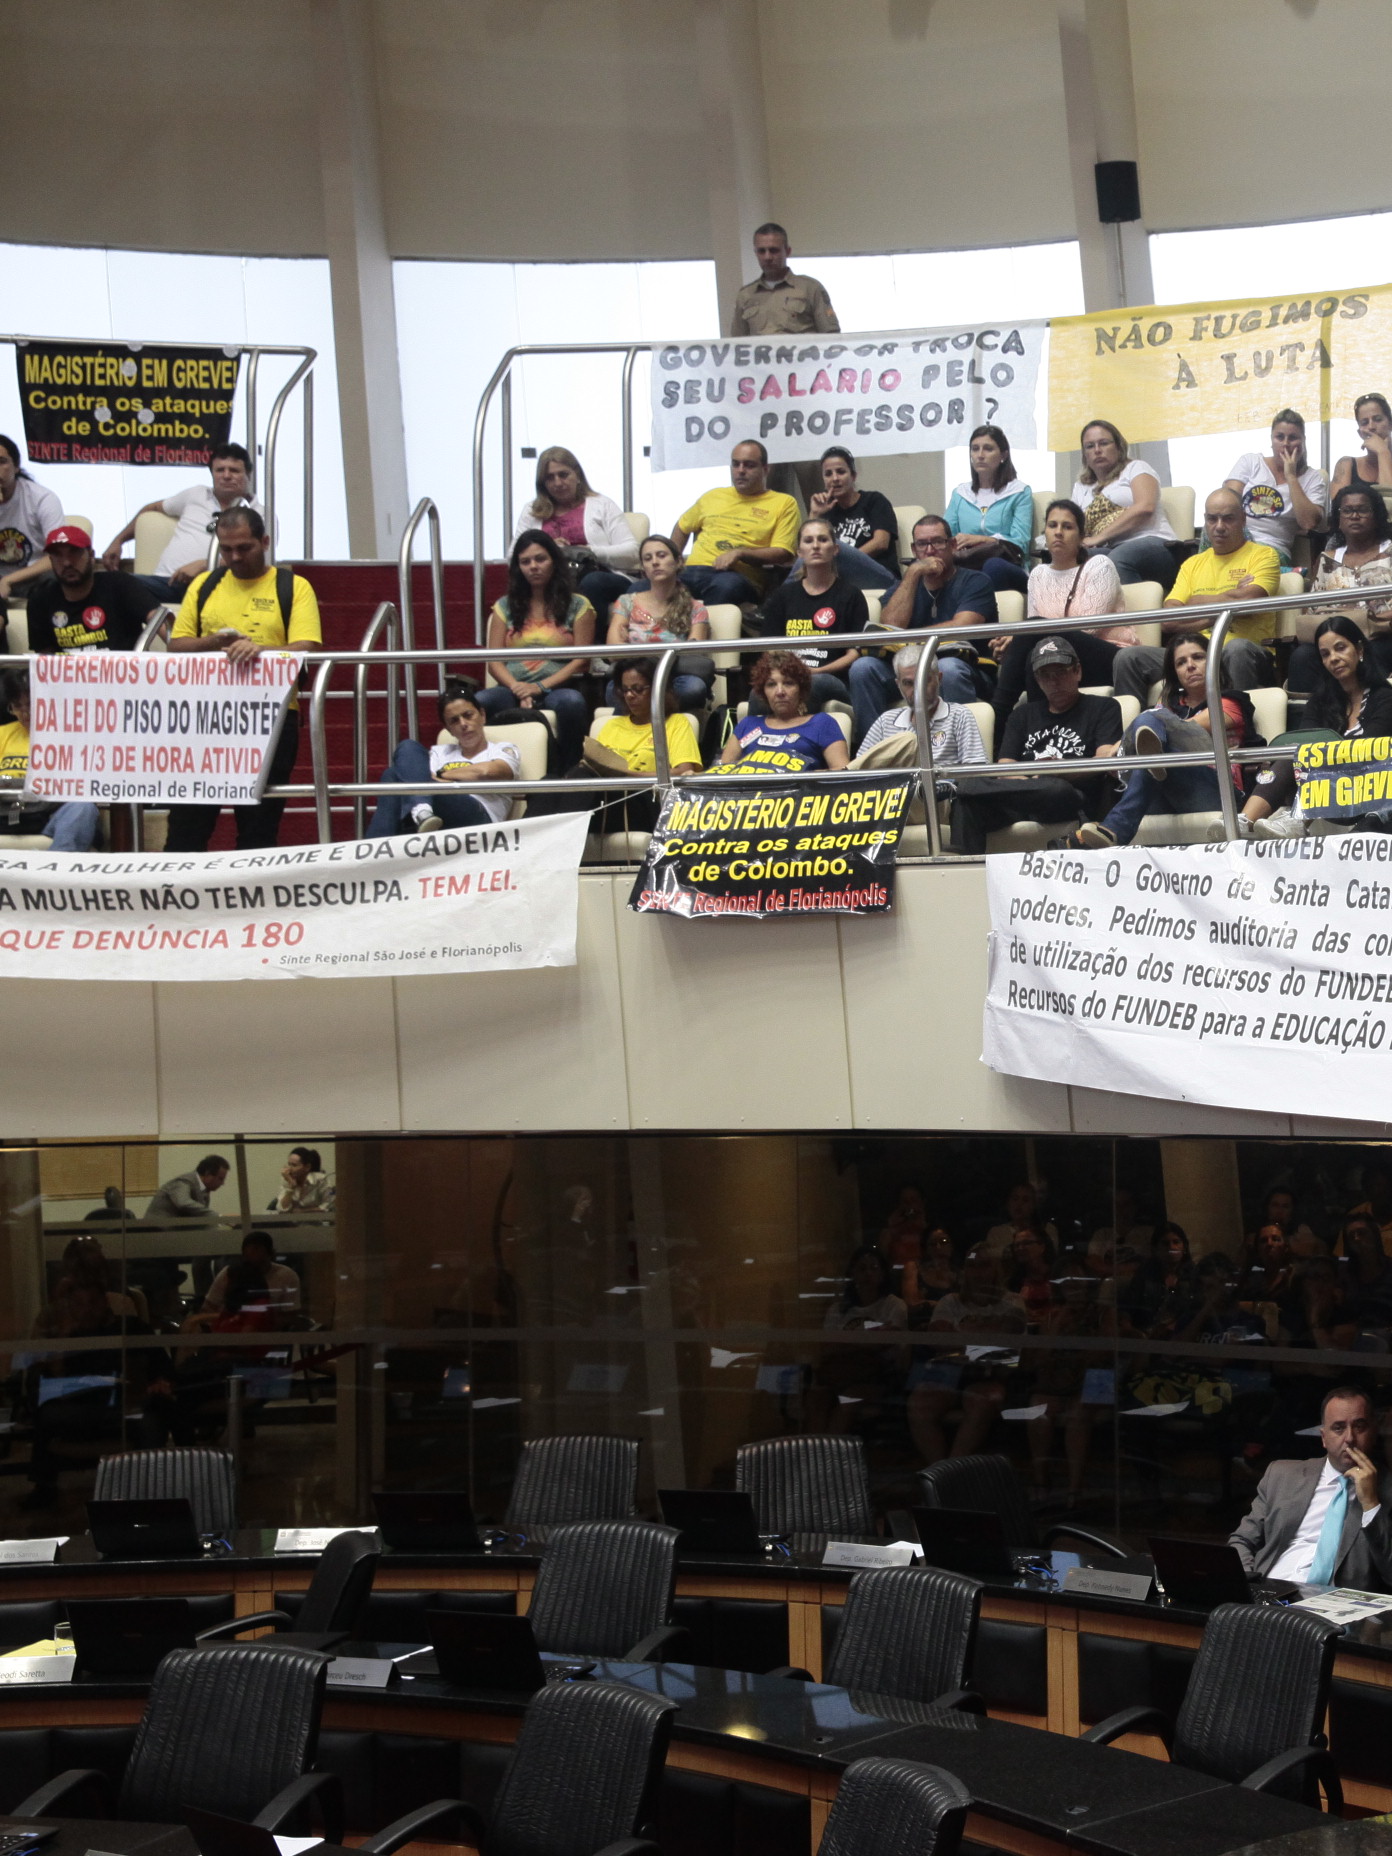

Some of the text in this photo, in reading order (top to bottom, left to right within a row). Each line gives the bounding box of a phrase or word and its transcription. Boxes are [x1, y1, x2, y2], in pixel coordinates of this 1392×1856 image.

[1095, 293, 1370, 356] NÃO FUGIMOS
[911, 329, 1025, 357] TROCA
[25, 350, 238, 390] MAGISTÉRIO EM GREVE!
[1171, 338, 1334, 391] À LUTA
[29, 390, 144, 412] Contra os
[661, 360, 1015, 409] SEU SALÁRIO PELO
[63, 417, 210, 438] de Colombo.
[685, 397, 966, 443] DO PROFESSOR
[28, 440, 151, 464] SINTE Regional de
[786, 619, 813, 630] BASTA
[36, 655, 300, 687] QUEREMOS O CUMPRIMENTO
[35, 698, 191, 735] DA LEI DO PISO DO
[30, 744, 73, 771] COM
[80, 745, 105, 772] 1/3
[112, 746, 136, 772] DE
[142, 747, 195, 773] HORA
[31, 778, 187, 801] SINTE Regional de
[1301, 779, 1330, 810] EM
[667, 787, 908, 831] MAGISTÉRIO EM GREVE!
[37, 862, 57, 871] A
[69, 861, 196, 874] MULHER
[204, 857, 225, 869] É
[229, 849, 322, 869] CRIME
[403, 828, 521, 859] CADEIA!
[664, 830, 898, 857] Contra os ataques
[689, 856, 854, 882] de Colombo.
[1105, 860, 1120, 888] O
[1136, 864, 1212, 897] Governo
[1227, 872, 1255, 901] de
[1269, 877, 1330, 908] Santa
[0, 869, 518, 911] A MULHER NÃO TEM DESCULPA. TEM LEI.
[637, 883, 888, 916] SINTE Regional de Florianópolis
[0, 921, 304, 952] QUE DENÚNCIA 180
[1010, 895, 1093, 929] poderes.
[1109, 905, 1197, 941] Pedimos
[1209, 919, 1298, 950] auditoria
[1311, 924, 1351, 954] das
[280, 942, 523, 965] Sinte Regional São José e Florianópolis
[1033, 939, 1127, 979] utilização
[1182, 964, 1271, 994] recursos
[1007, 980, 1075, 1016] Recursos
[1111, 995, 1197, 1031] FUNDEB
[1199, 1010, 1248, 1040] para
[1270, 1010, 1386, 1053] EDUCAÇÃO
